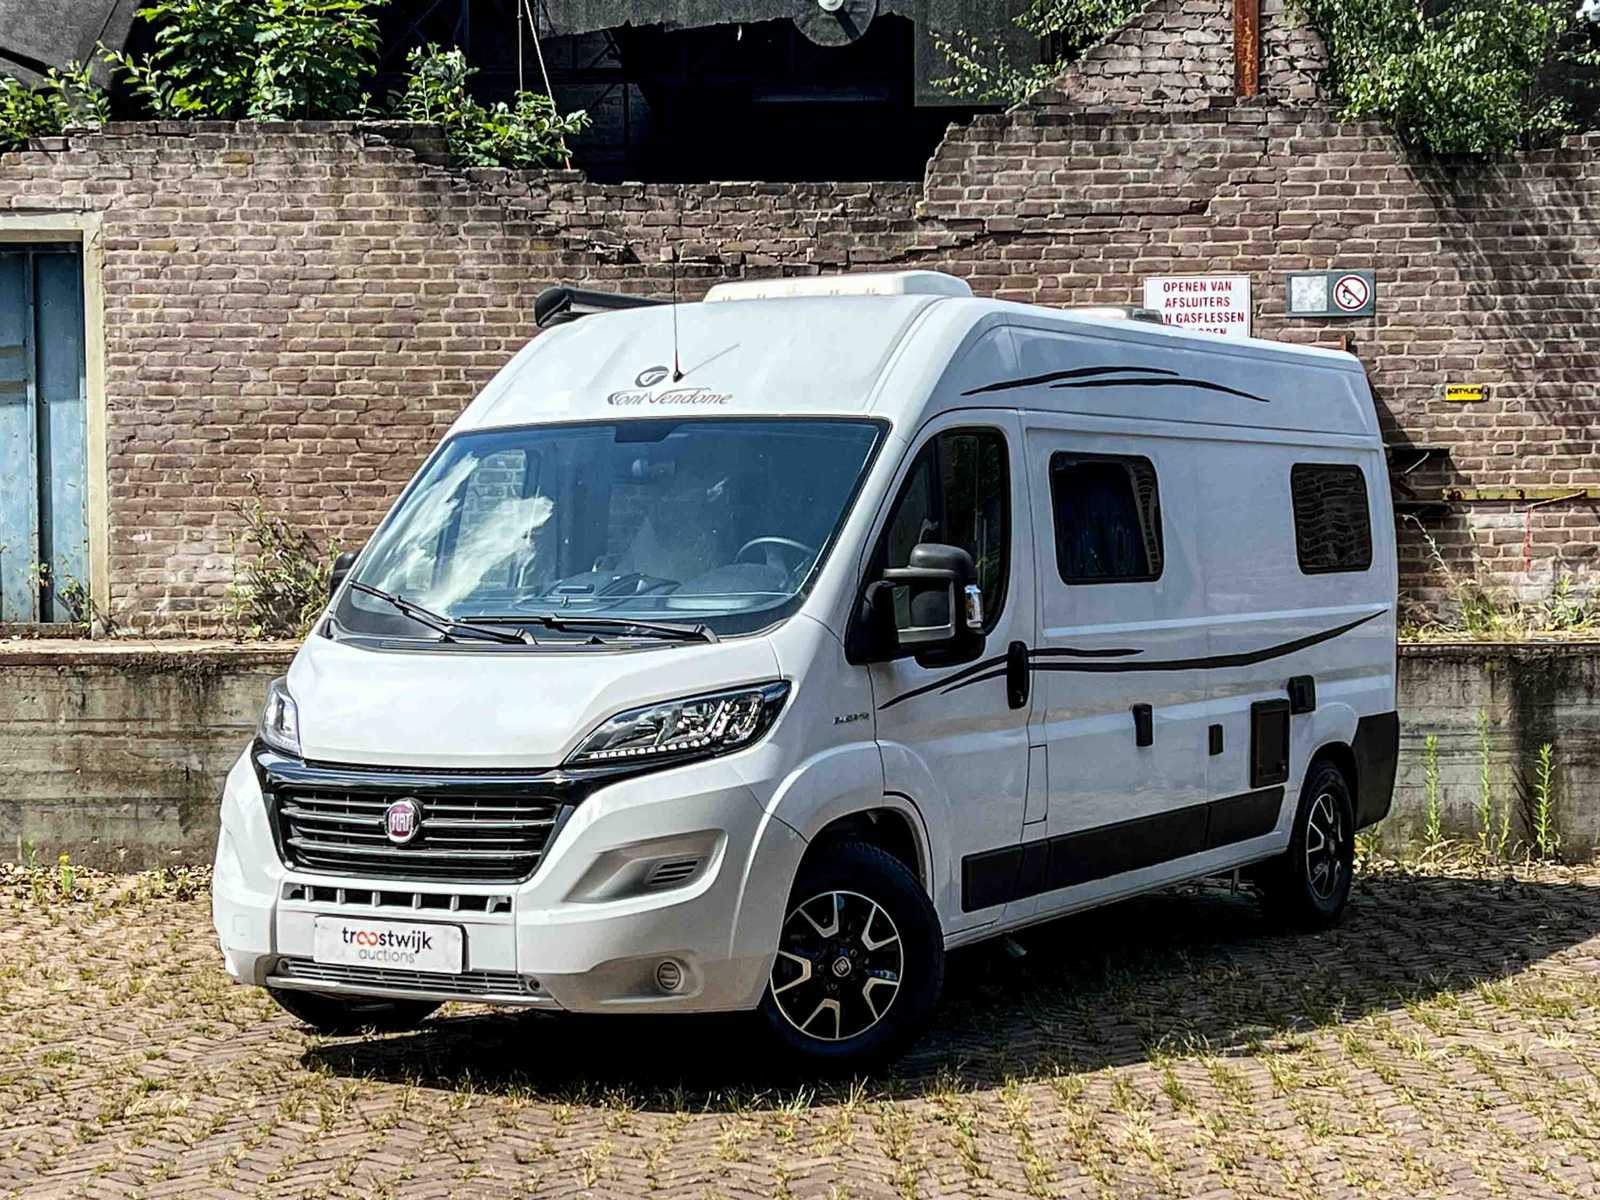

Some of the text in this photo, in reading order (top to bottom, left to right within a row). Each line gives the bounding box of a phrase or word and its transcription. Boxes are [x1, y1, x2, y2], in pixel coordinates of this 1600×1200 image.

[1163, 280, 1232, 292] OPENEN VAN
[1164, 296, 1230, 308] AFSLUITERS
[1176, 311, 1245, 324] GASFLESSEN
[342, 926, 432, 954] troostwijk
[359, 948, 416, 963] auctions
